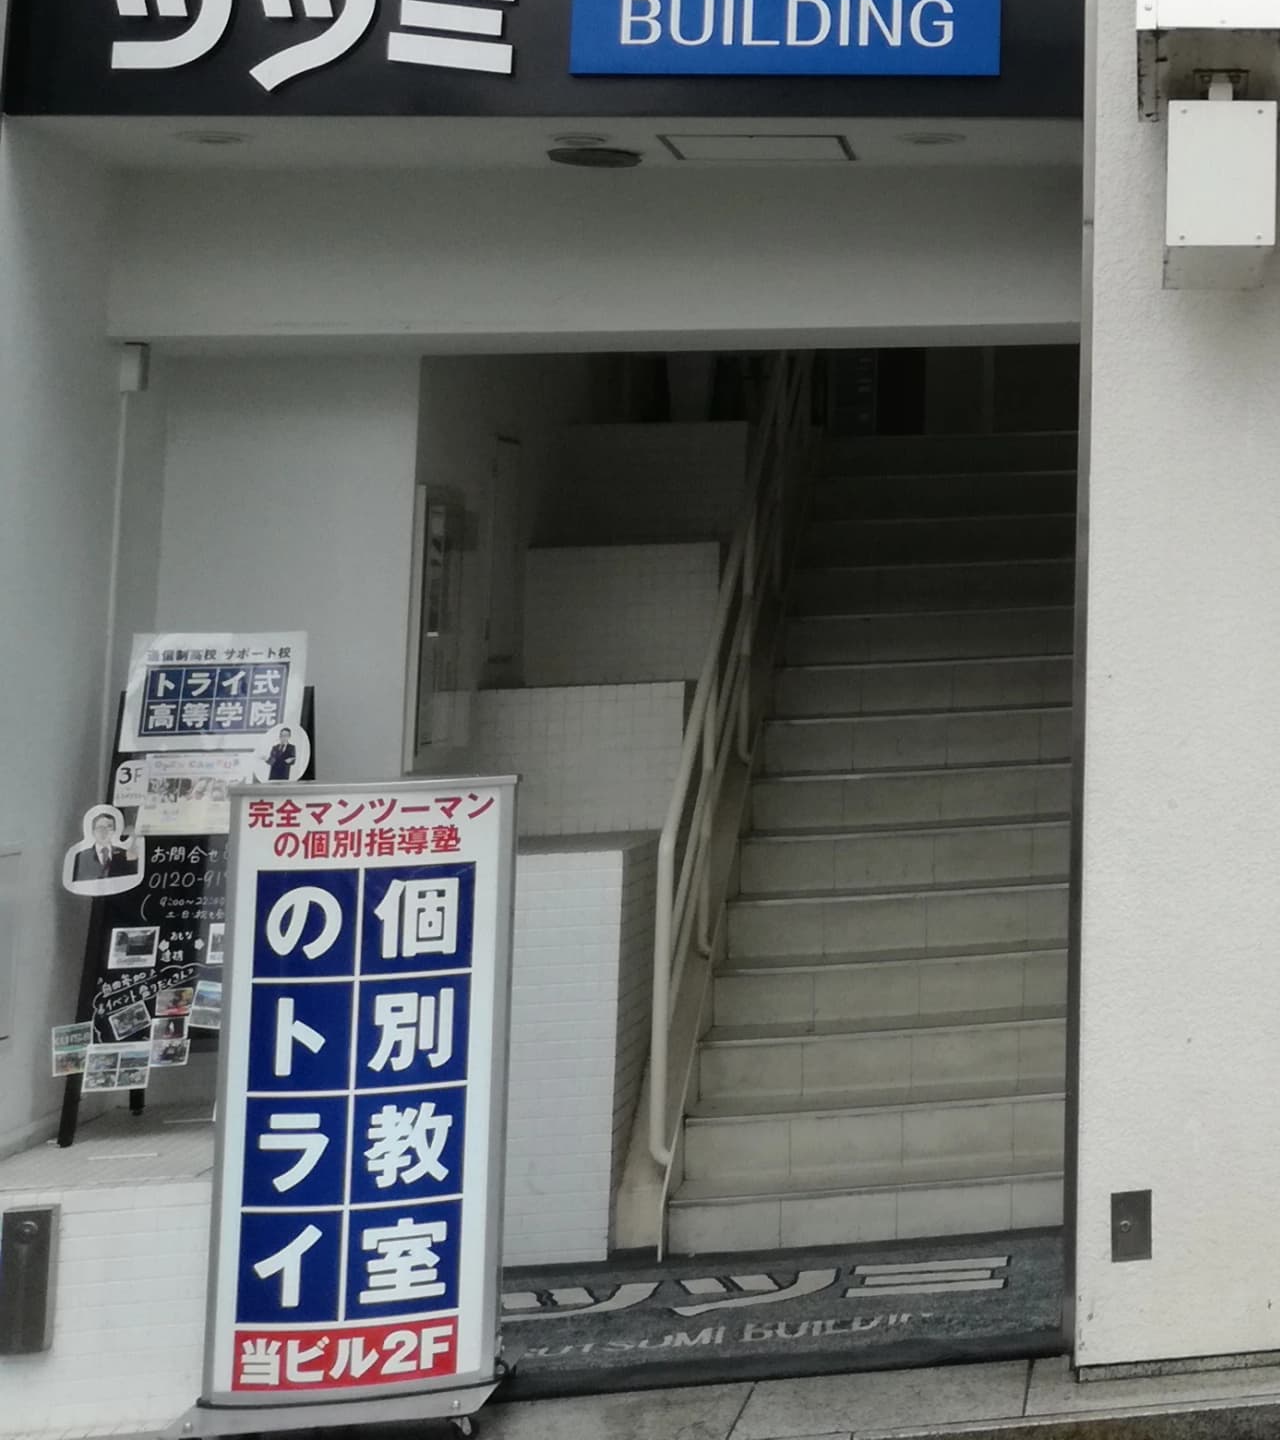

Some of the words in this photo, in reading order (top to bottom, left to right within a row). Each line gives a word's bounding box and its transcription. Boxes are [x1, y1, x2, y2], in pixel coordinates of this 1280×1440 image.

[157, 669, 281, 698] トライ式
[148, 699, 278, 730] 高等学院
[248, 792, 495, 829] 完全マンツーマン
[274, 824, 462, 860] の個別指導塾
[252, 885, 344, 1309] のトライ
[359, 876, 460, 1307] 個別教室
[238, 1326, 455, 1388] 当ビル2F
